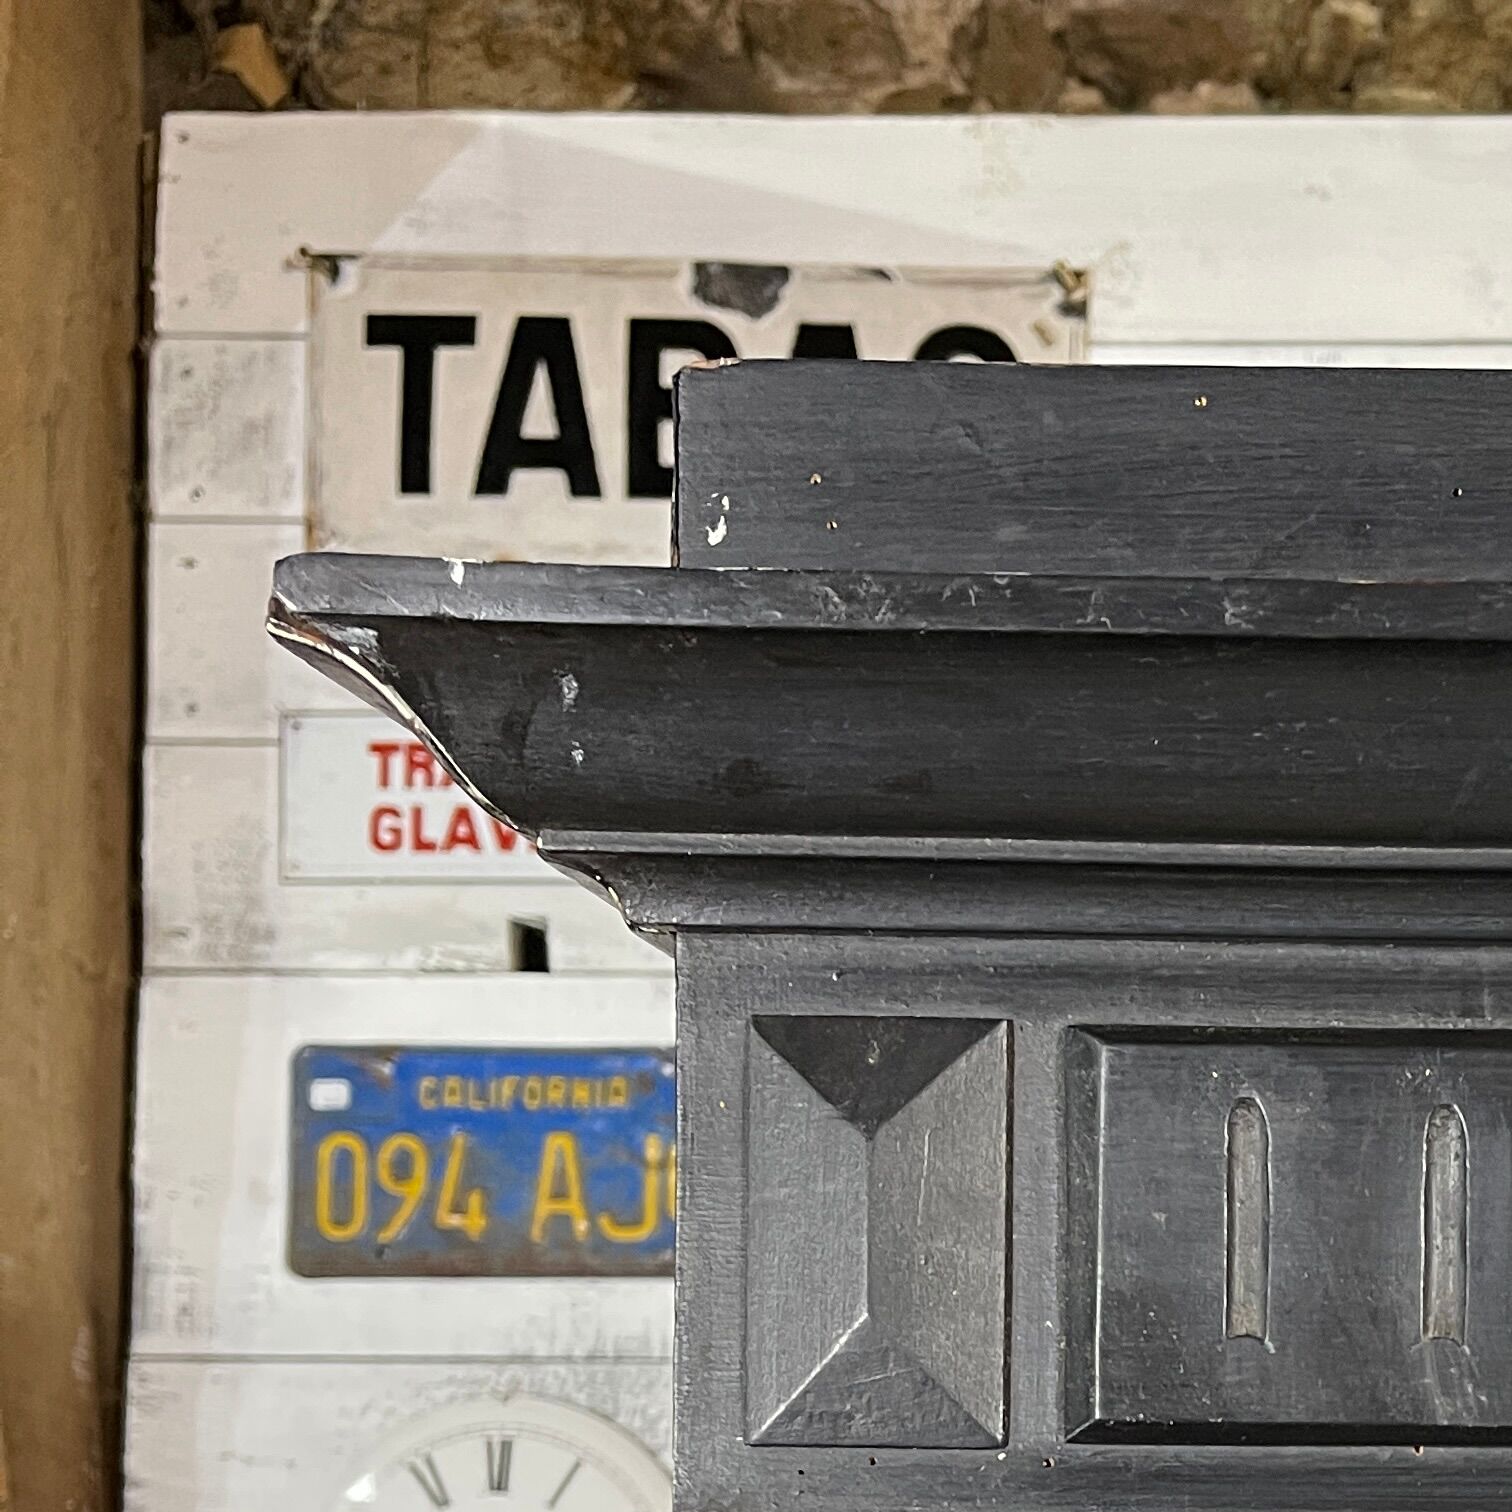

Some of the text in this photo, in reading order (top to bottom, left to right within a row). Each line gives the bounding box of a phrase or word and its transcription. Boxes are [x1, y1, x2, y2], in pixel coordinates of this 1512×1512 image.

[364, 313, 1019, 498] TAB
[368, 741, 455, 788] TR
[418, 1074, 632, 1111] CALIFORNIA
[314, 1130, 676, 1244] 094 AJ
